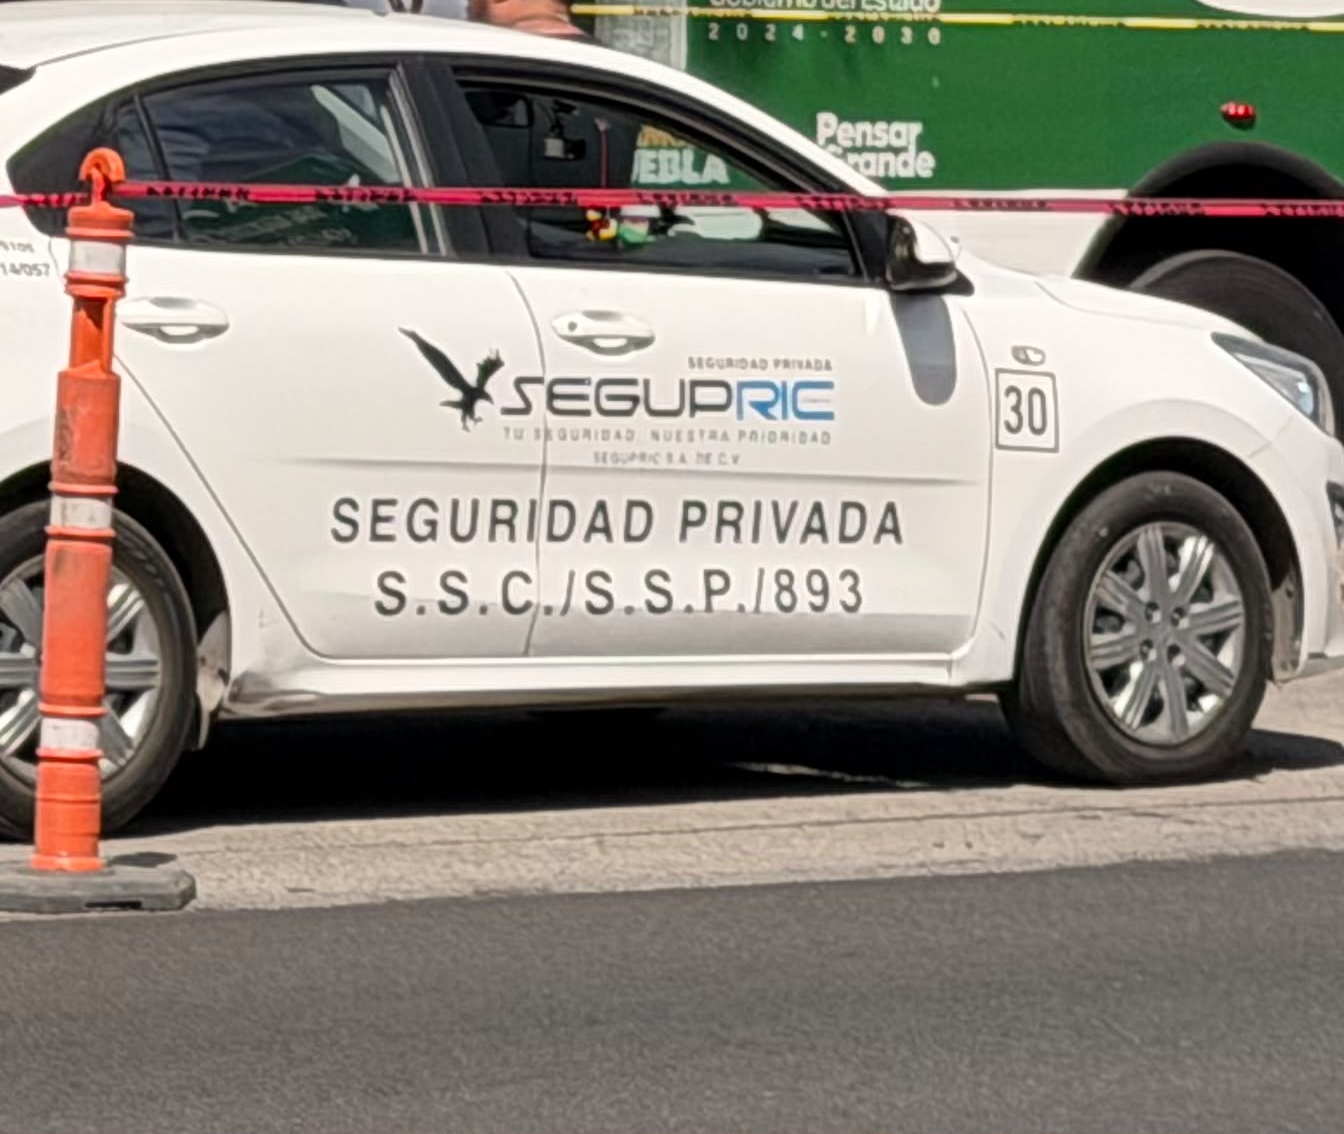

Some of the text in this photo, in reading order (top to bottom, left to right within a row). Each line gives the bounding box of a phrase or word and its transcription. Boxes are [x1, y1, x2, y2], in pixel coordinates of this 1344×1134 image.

[816, 111, 923, 149] Pensar
[688, 356, 833, 372] SEGURIDAD PRIVADA
[500, 375, 835, 421] SEGUPRIC
[1003, 384, 1048, 436] 30
[503, 425, 525, 441] TU
[650, 428, 730, 443] NUESTRA
[738, 429, 831, 445] PRIORIDAD
[593, 451, 660, 465] SEGUPRIC
[696, 452, 712, 465] DE
[330, 497, 904, 545] SEGURIDAD PRIVADA
[374, 568, 864, 617] S.S.C./S.S.P./893
